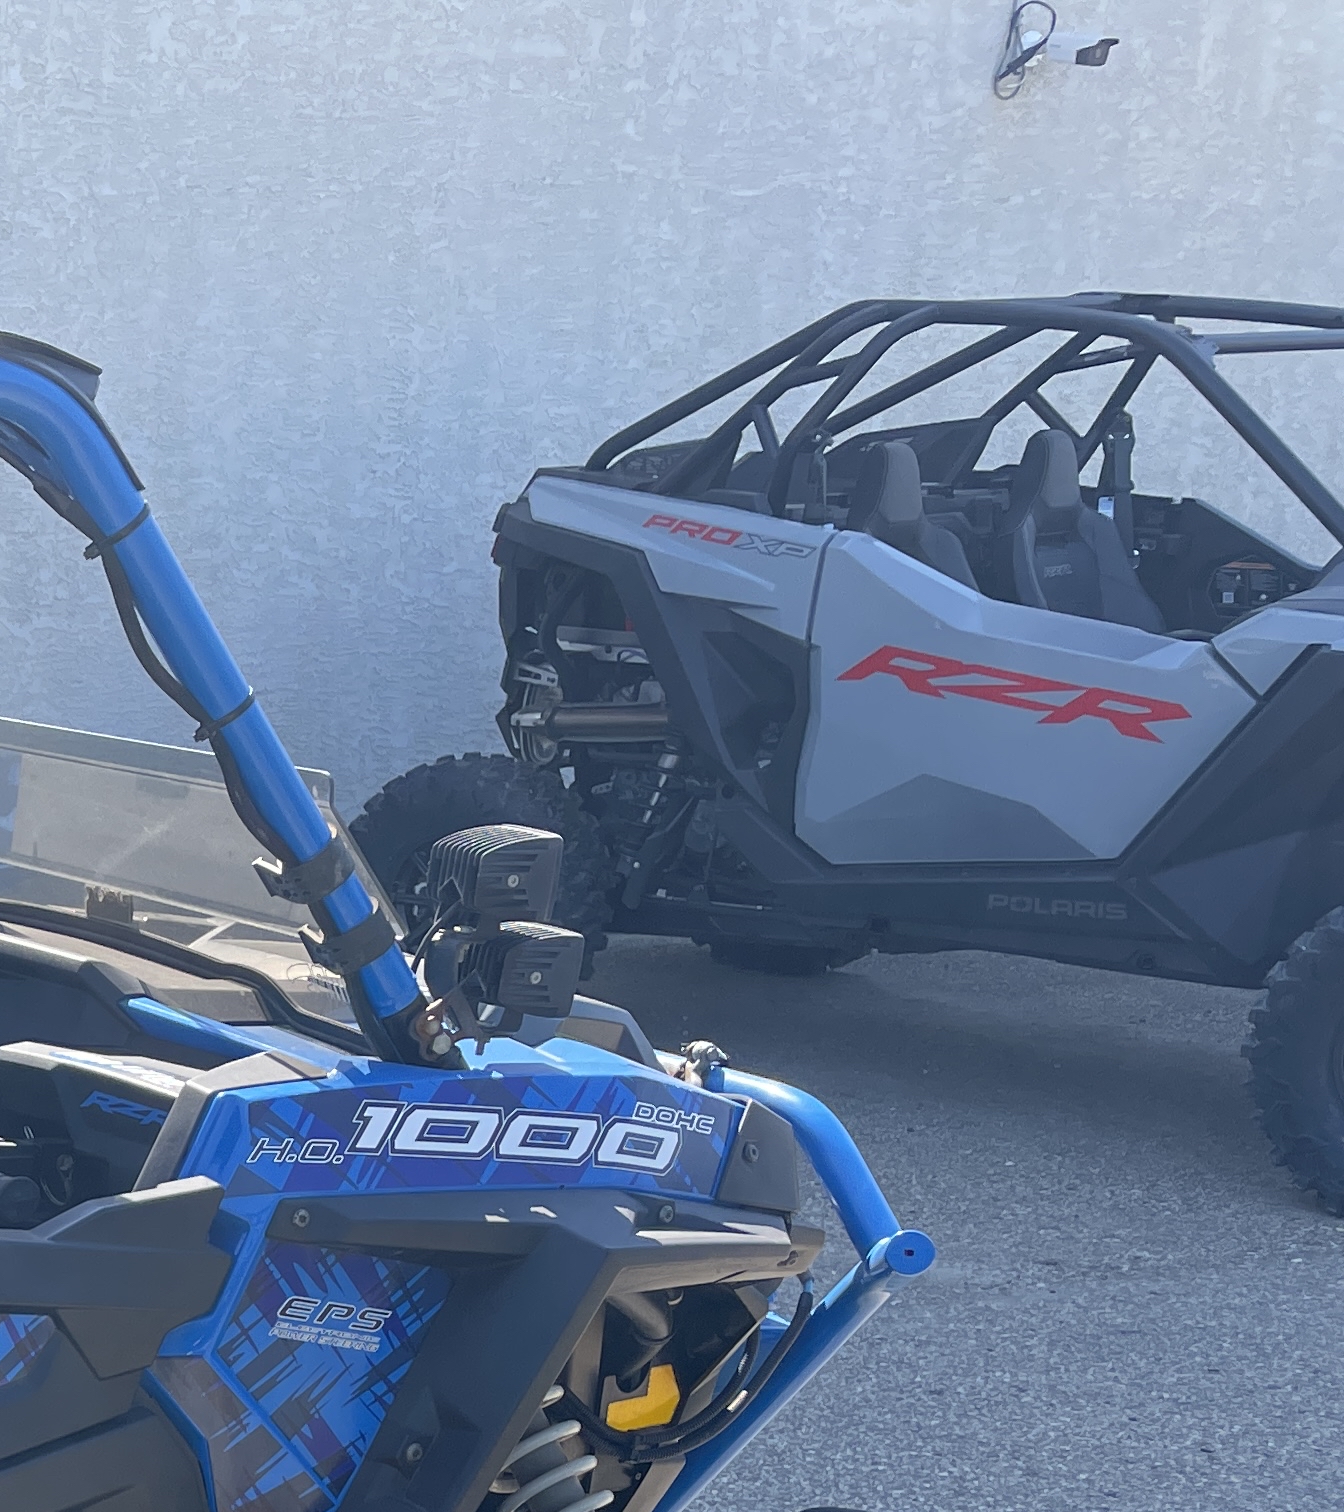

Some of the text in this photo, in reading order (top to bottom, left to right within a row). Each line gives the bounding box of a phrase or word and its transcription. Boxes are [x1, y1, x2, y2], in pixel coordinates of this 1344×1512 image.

[642, 514, 817, 558] PRO XP
[836, 645, 1193, 744] RZR
[987, 894, 1128, 920] POLARIS
[346, 1099, 685, 1177] 1000
[632, 1102, 716, 1135] DOHC
[277, 1296, 392, 1332] EPS
